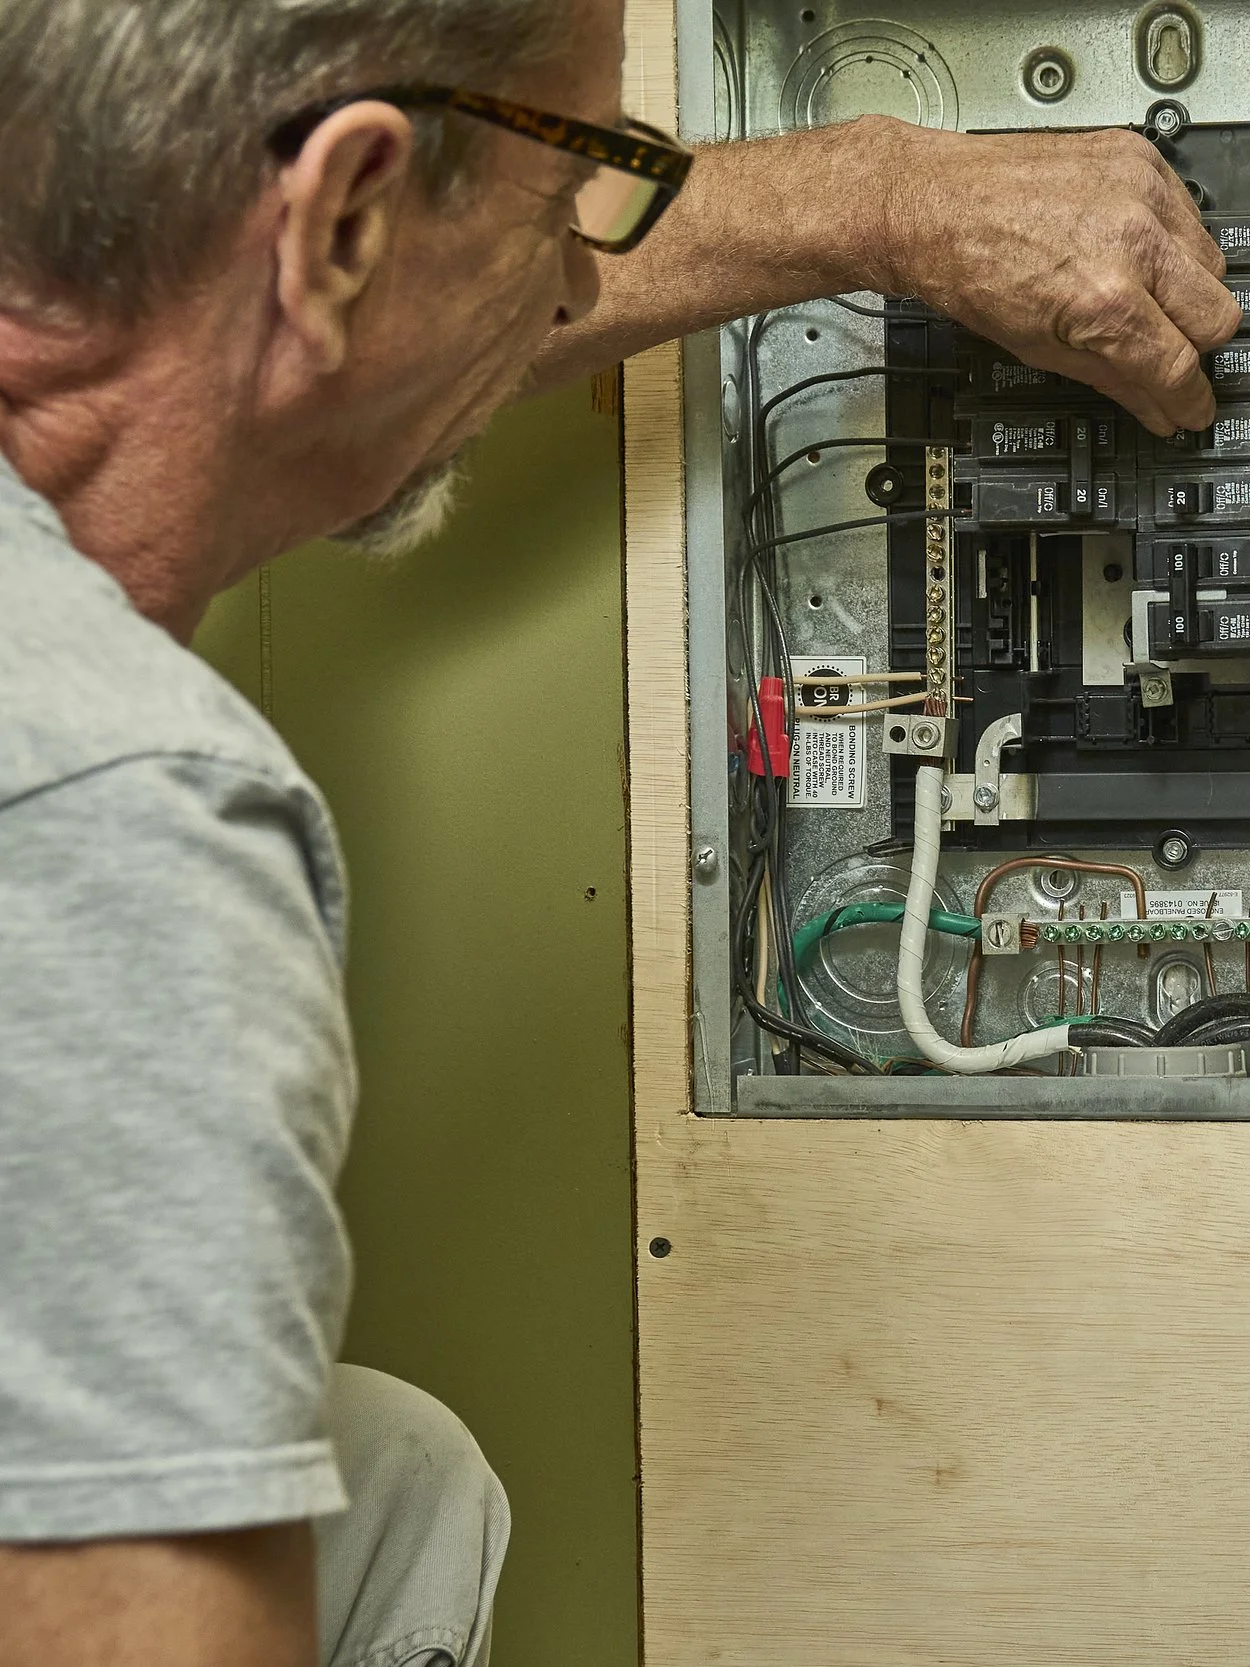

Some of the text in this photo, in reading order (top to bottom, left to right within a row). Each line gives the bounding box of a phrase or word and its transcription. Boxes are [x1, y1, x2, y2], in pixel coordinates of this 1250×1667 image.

[1077, 427, 1087, 440] 20
[1077, 489, 1087, 503] 20
[1098, 488, 1108, 508] On/I
[1176, 491, 1186, 505] 20
[1174, 554, 1184, 571] 100
[1175, 616, 1185, 633] 100
[829, 686, 839, 700] BR
[831, 733, 838, 743] TO
[805, 757, 811, 767] OF
[847, 725, 856, 799] BONDING SCREW
[792, 759, 801, 800] NEUTRAL
[812, 789, 818, 798] 40
